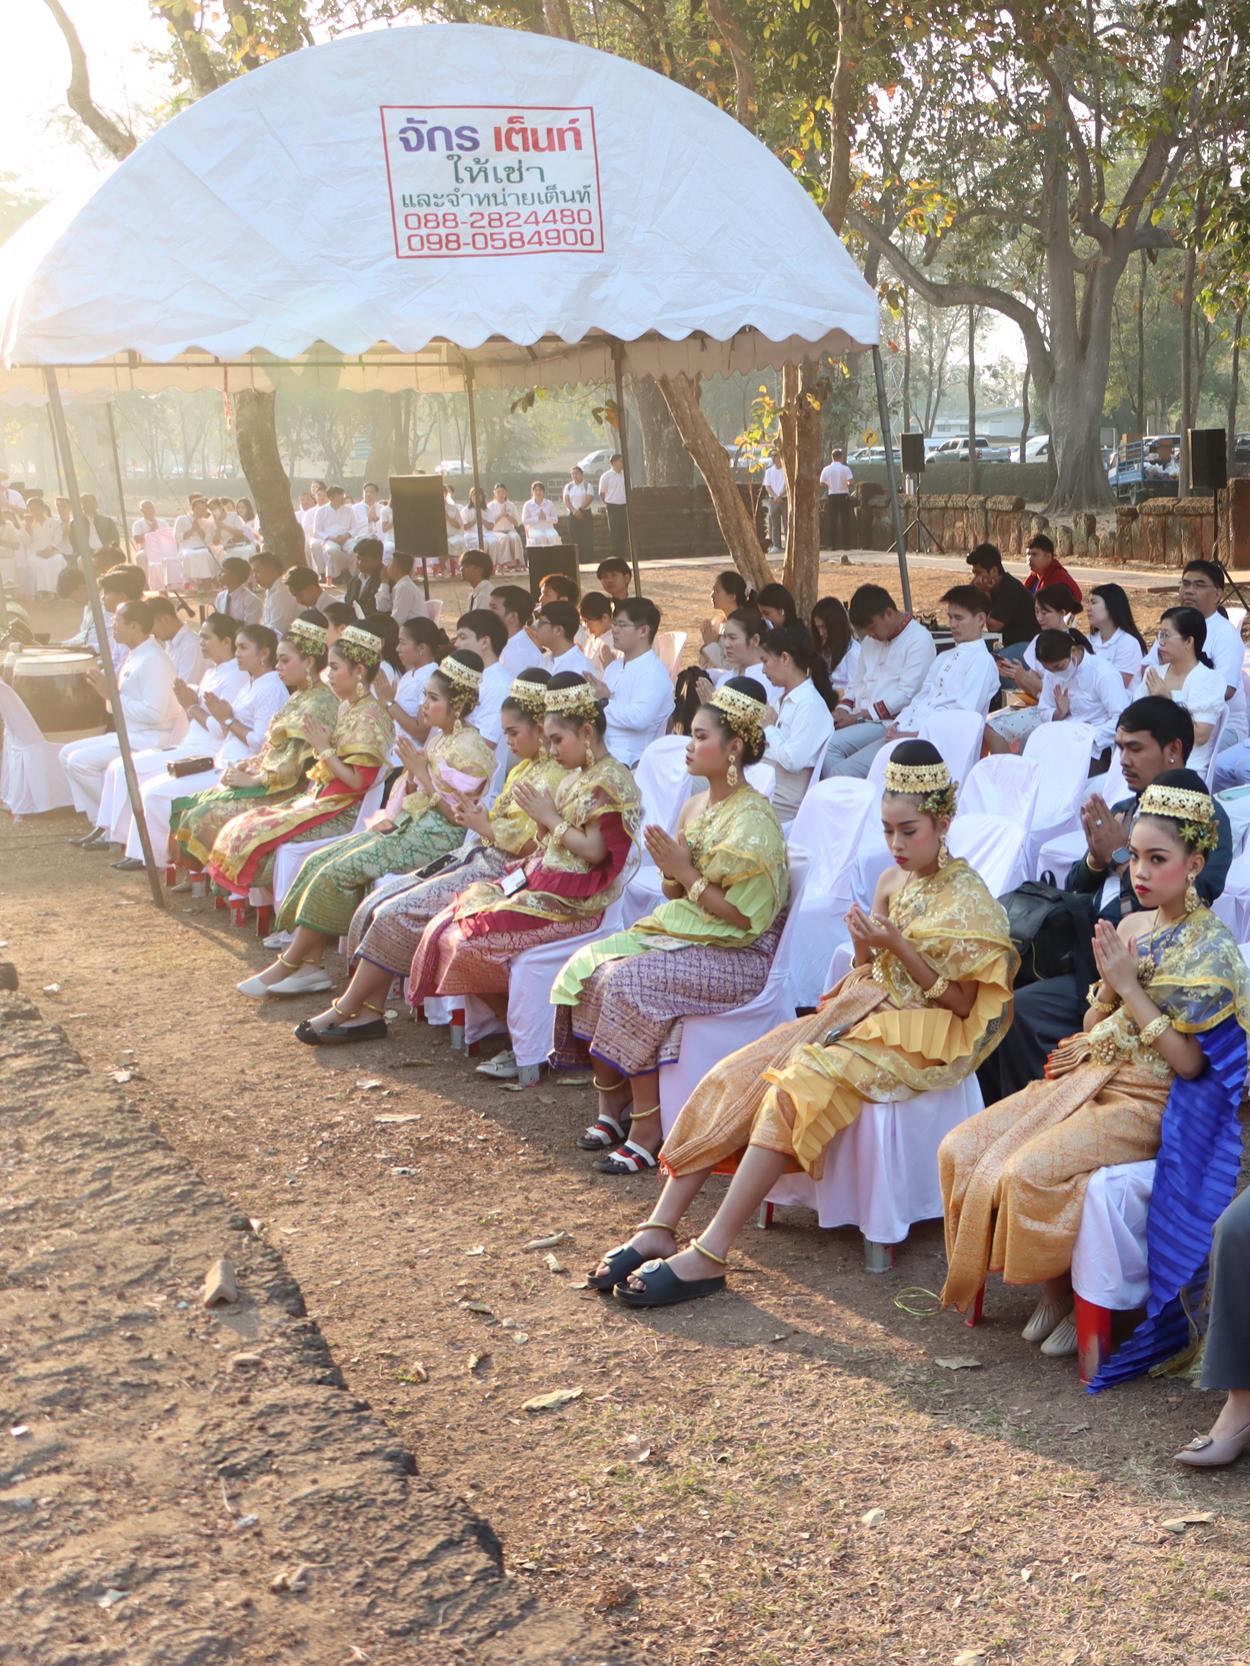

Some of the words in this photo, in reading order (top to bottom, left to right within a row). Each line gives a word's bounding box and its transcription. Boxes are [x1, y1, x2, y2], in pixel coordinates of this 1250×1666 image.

[398, 117, 480, 152] จักร
[493, 116, 583, 152] เต็นท์
[446, 154, 545, 184] ให้เช่า
[401, 184, 592, 208] และจำหน่ายเต็นท์
[404, 208, 592, 231] 088-2824480
[407, 228, 594, 252] 098-0584900
